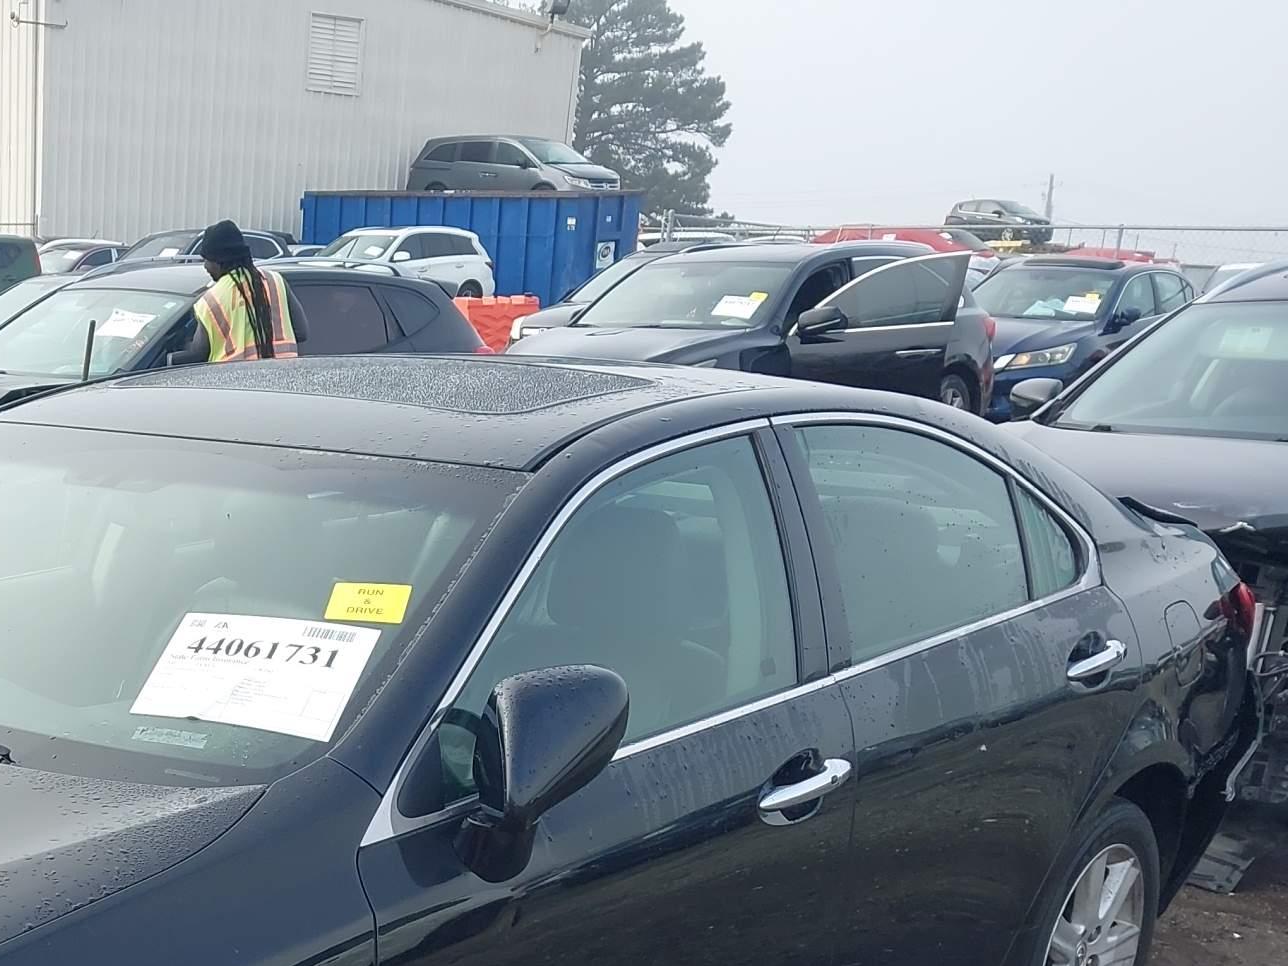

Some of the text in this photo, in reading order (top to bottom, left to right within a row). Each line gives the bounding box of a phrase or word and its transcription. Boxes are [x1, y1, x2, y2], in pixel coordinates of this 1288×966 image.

[357, 588, 384, 596] RUN
[346, 606, 384, 615] DRIVE
[187, 636, 339, 668] 44061731
